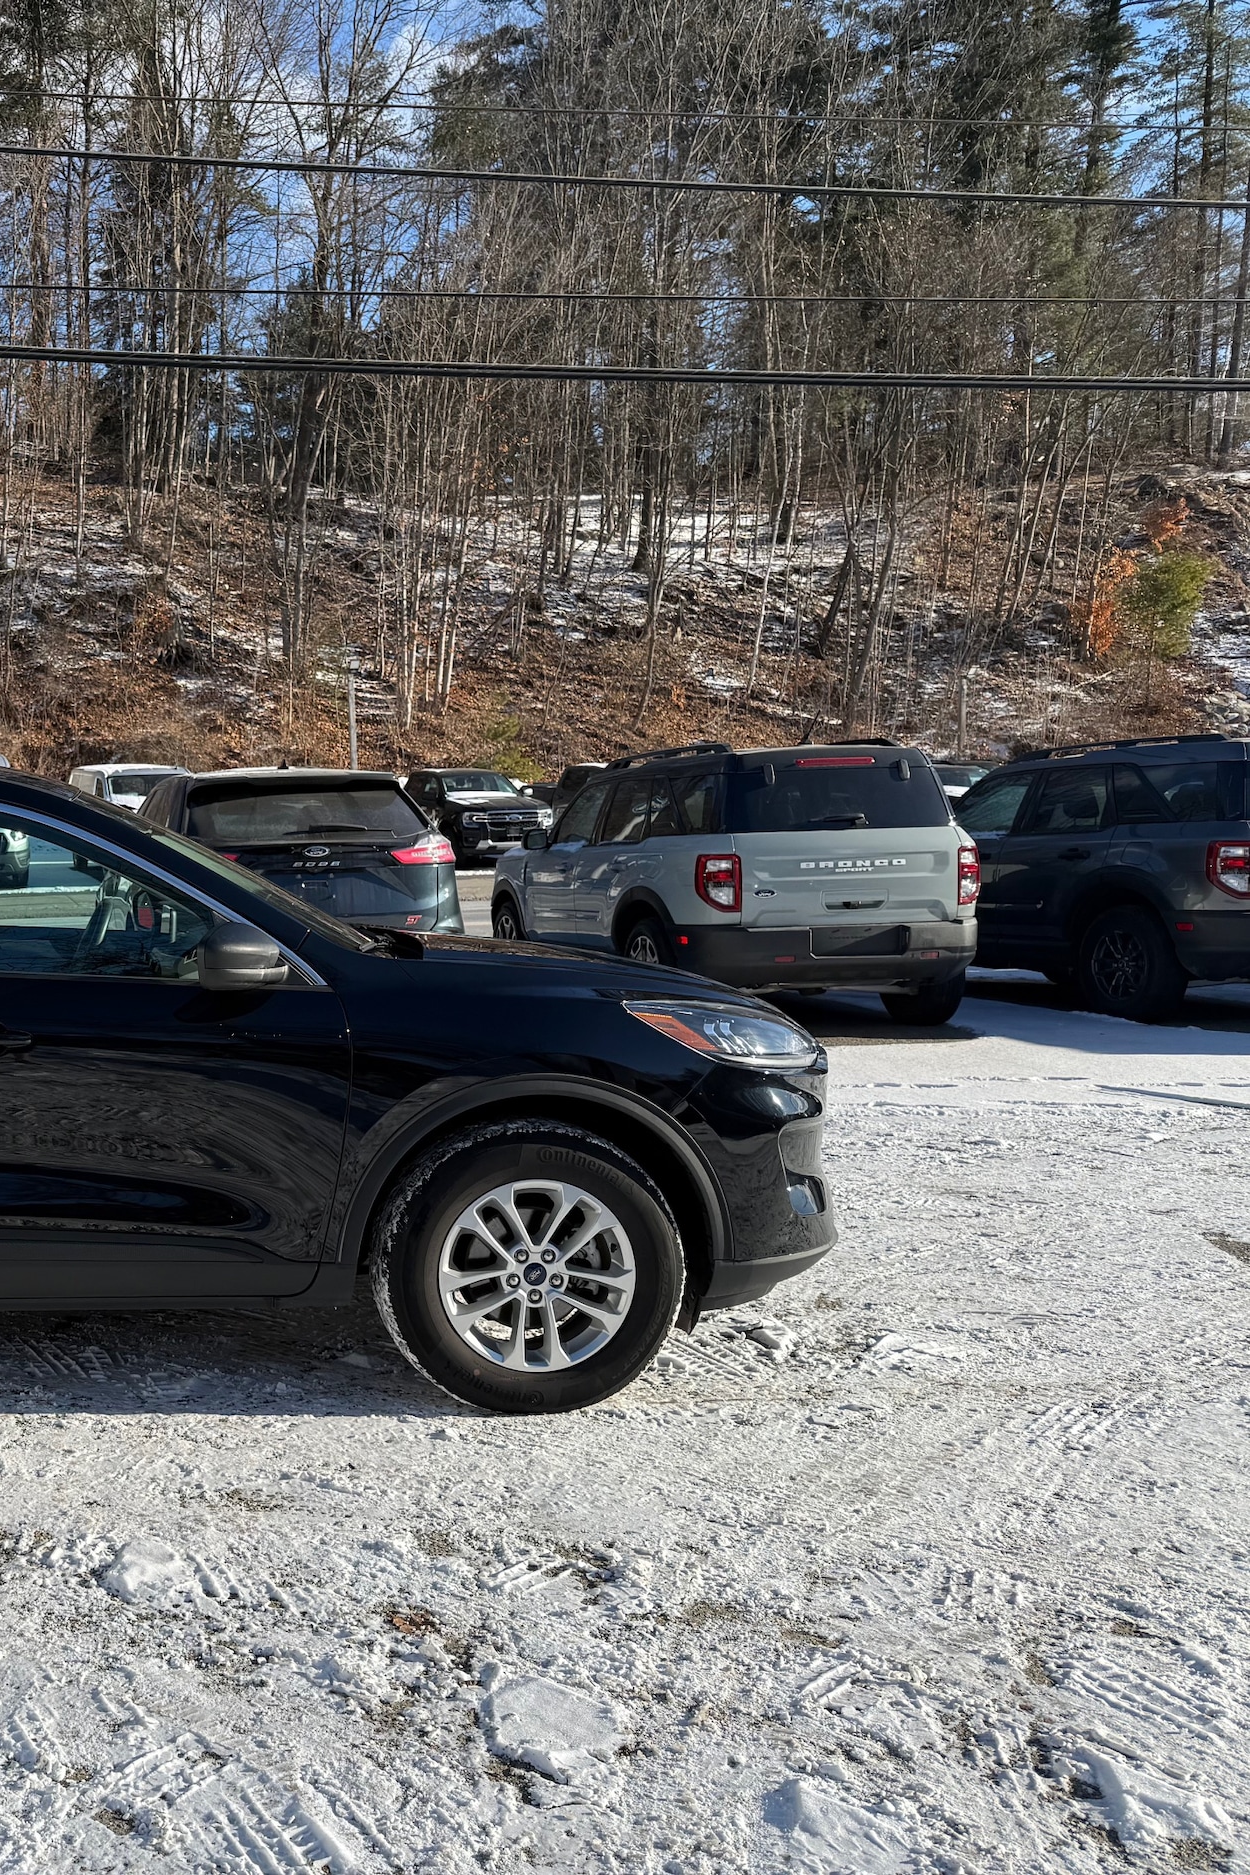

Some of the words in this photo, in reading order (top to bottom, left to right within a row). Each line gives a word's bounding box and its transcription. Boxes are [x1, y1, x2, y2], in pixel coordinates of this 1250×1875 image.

[800, 858, 907, 869] BRONCO
[405, 915, 423, 925] ST
[536, 1146, 626, 1188] Continental
